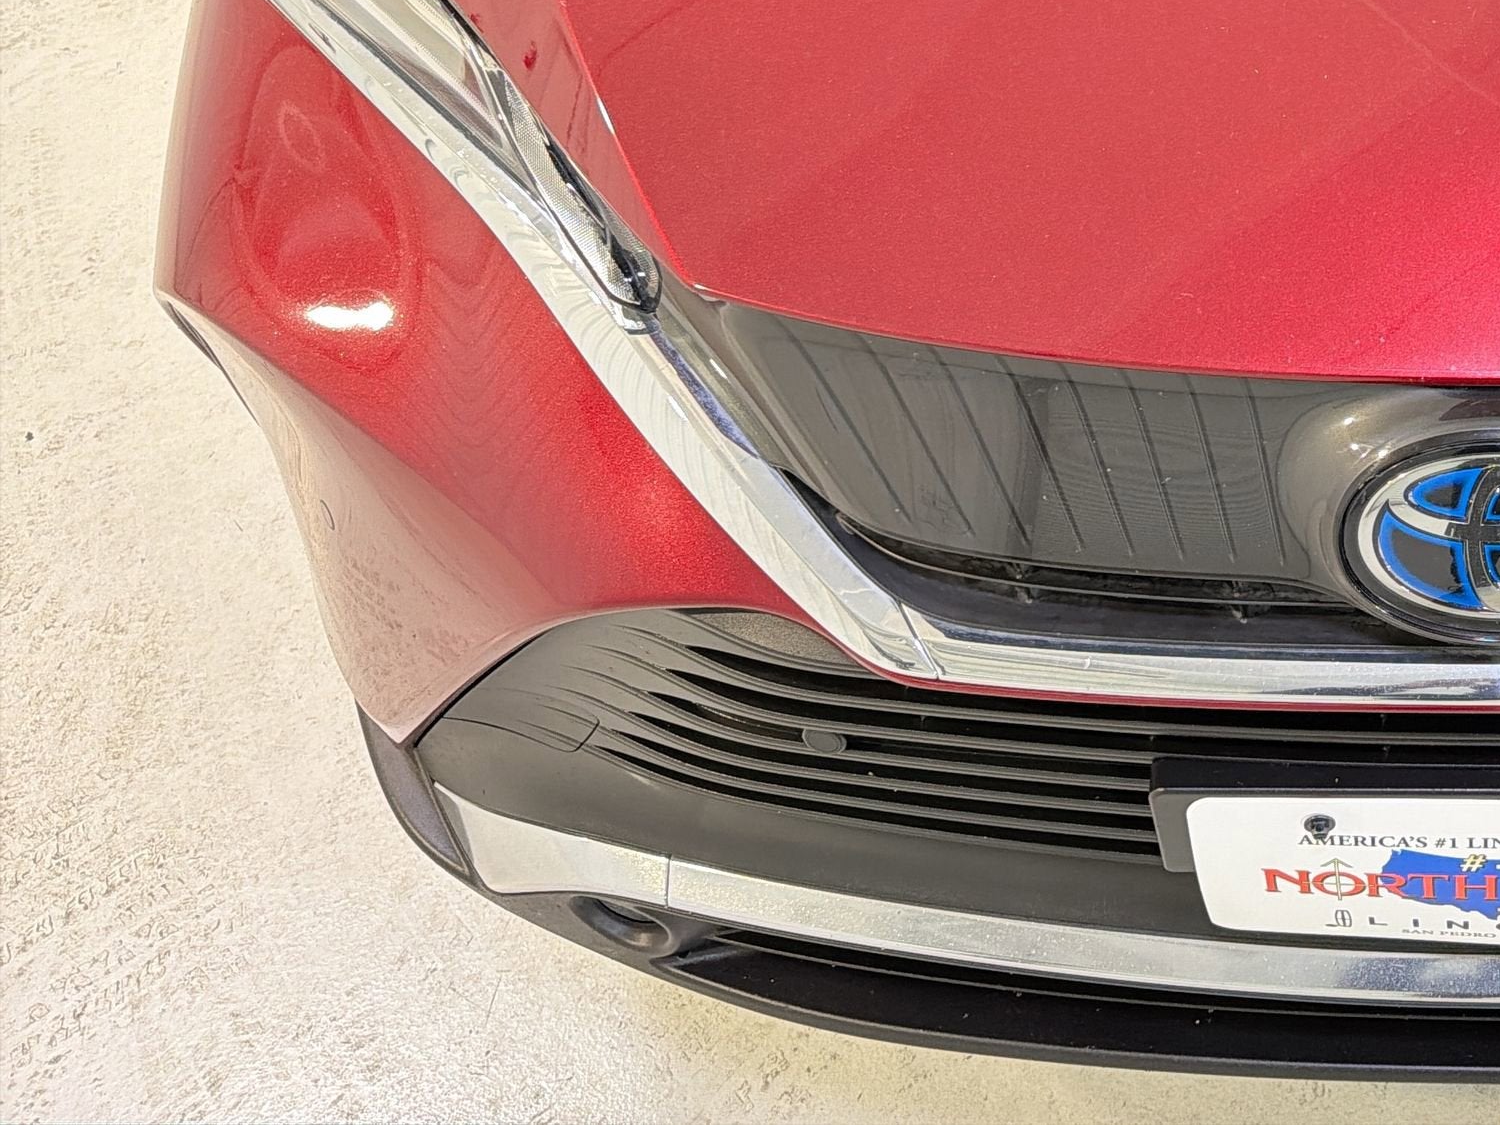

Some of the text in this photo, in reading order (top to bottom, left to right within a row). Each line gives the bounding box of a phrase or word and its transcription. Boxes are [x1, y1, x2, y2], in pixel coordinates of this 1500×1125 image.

[1297, 835, 1428, 849] AMERICA'S
[1435, 836, 1458, 849] #1
[1261, 868, 1500, 901] NORTH
[1401, 928, 1434, 936] SAN
[1440, 930, 1497, 939] PEDRO
